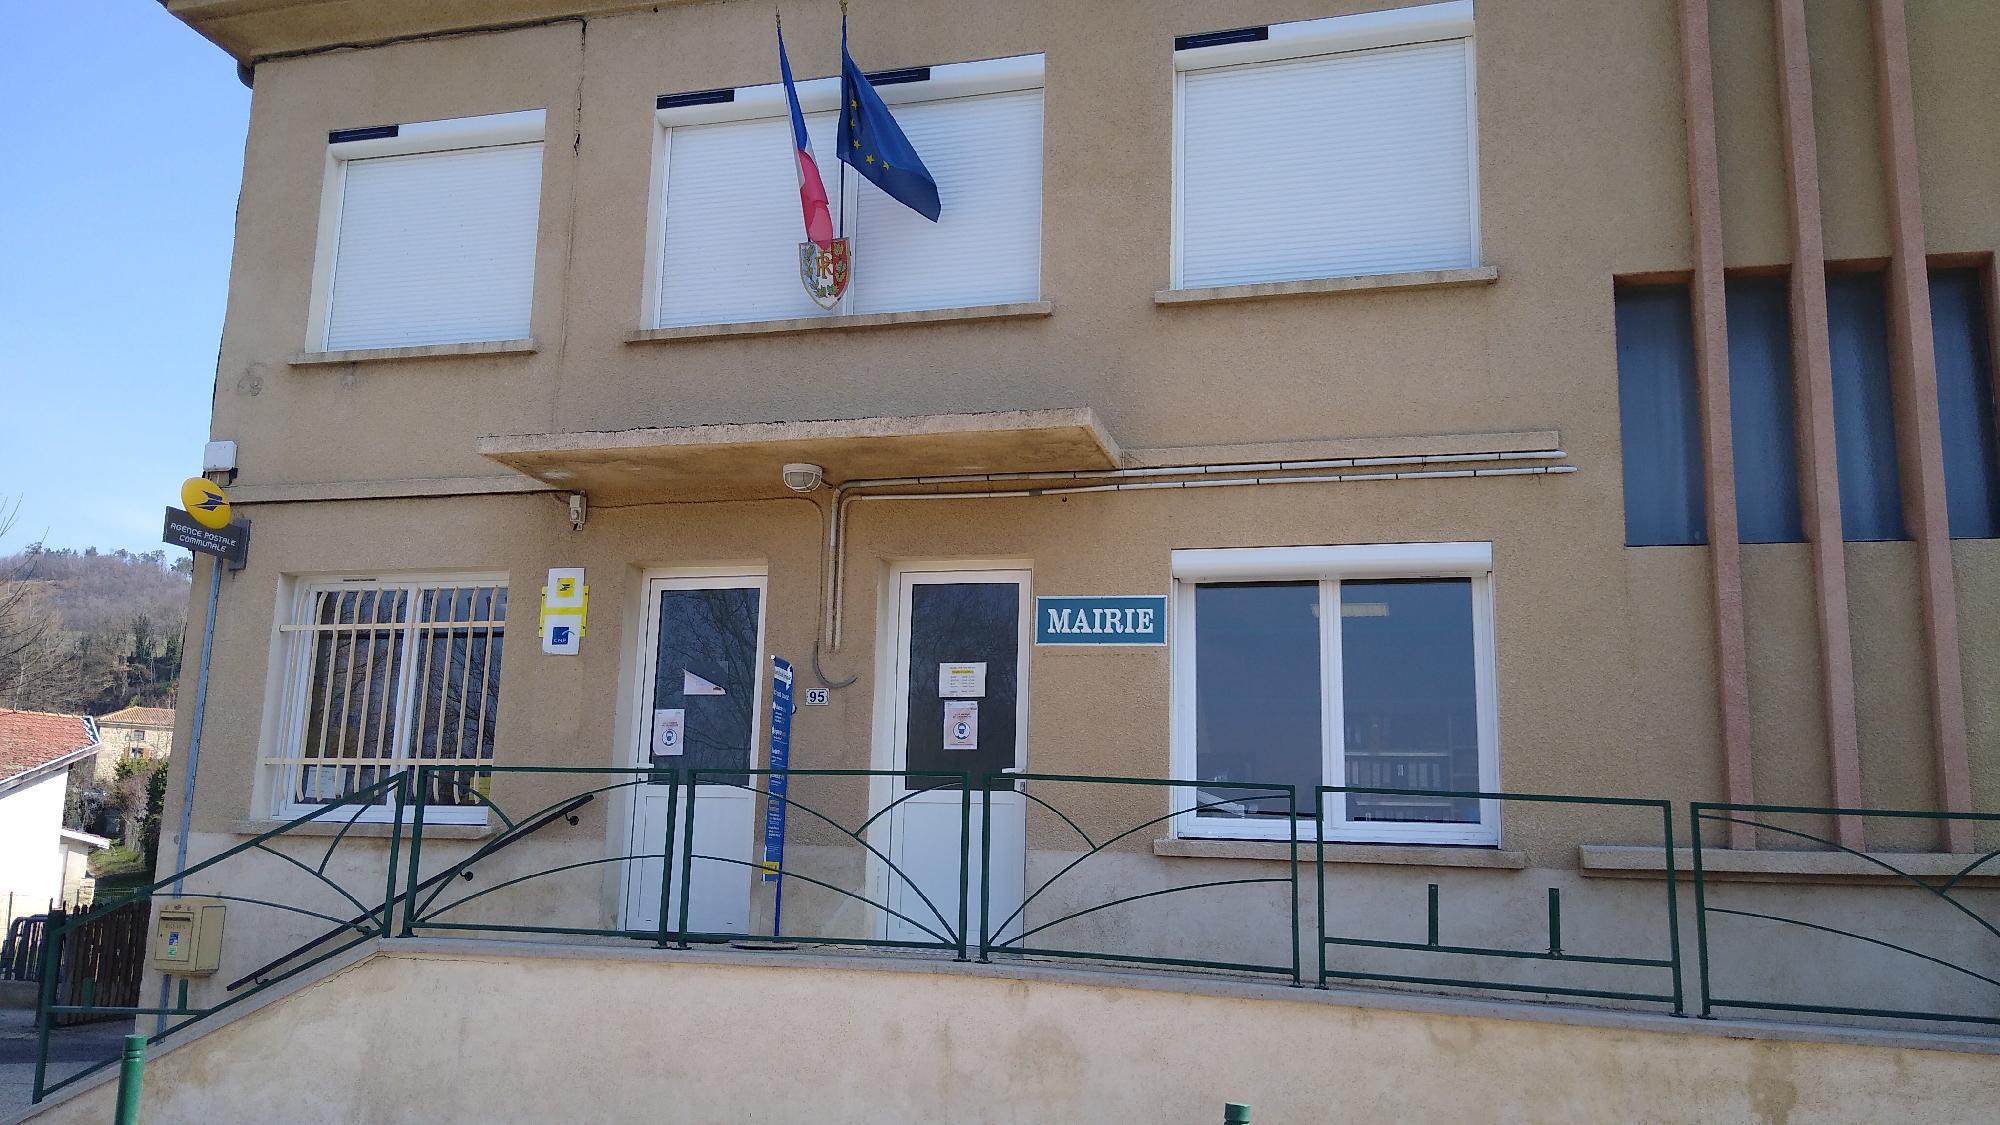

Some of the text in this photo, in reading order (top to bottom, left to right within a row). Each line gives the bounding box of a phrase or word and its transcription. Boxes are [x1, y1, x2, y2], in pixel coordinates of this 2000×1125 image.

[170, 522, 236, 546] AGENCE POSTALE
[179, 534, 227, 553] COMMUNALE
[1047, 608, 1154, 634] MAIRIE
[809, 691, 825, 703] 95
